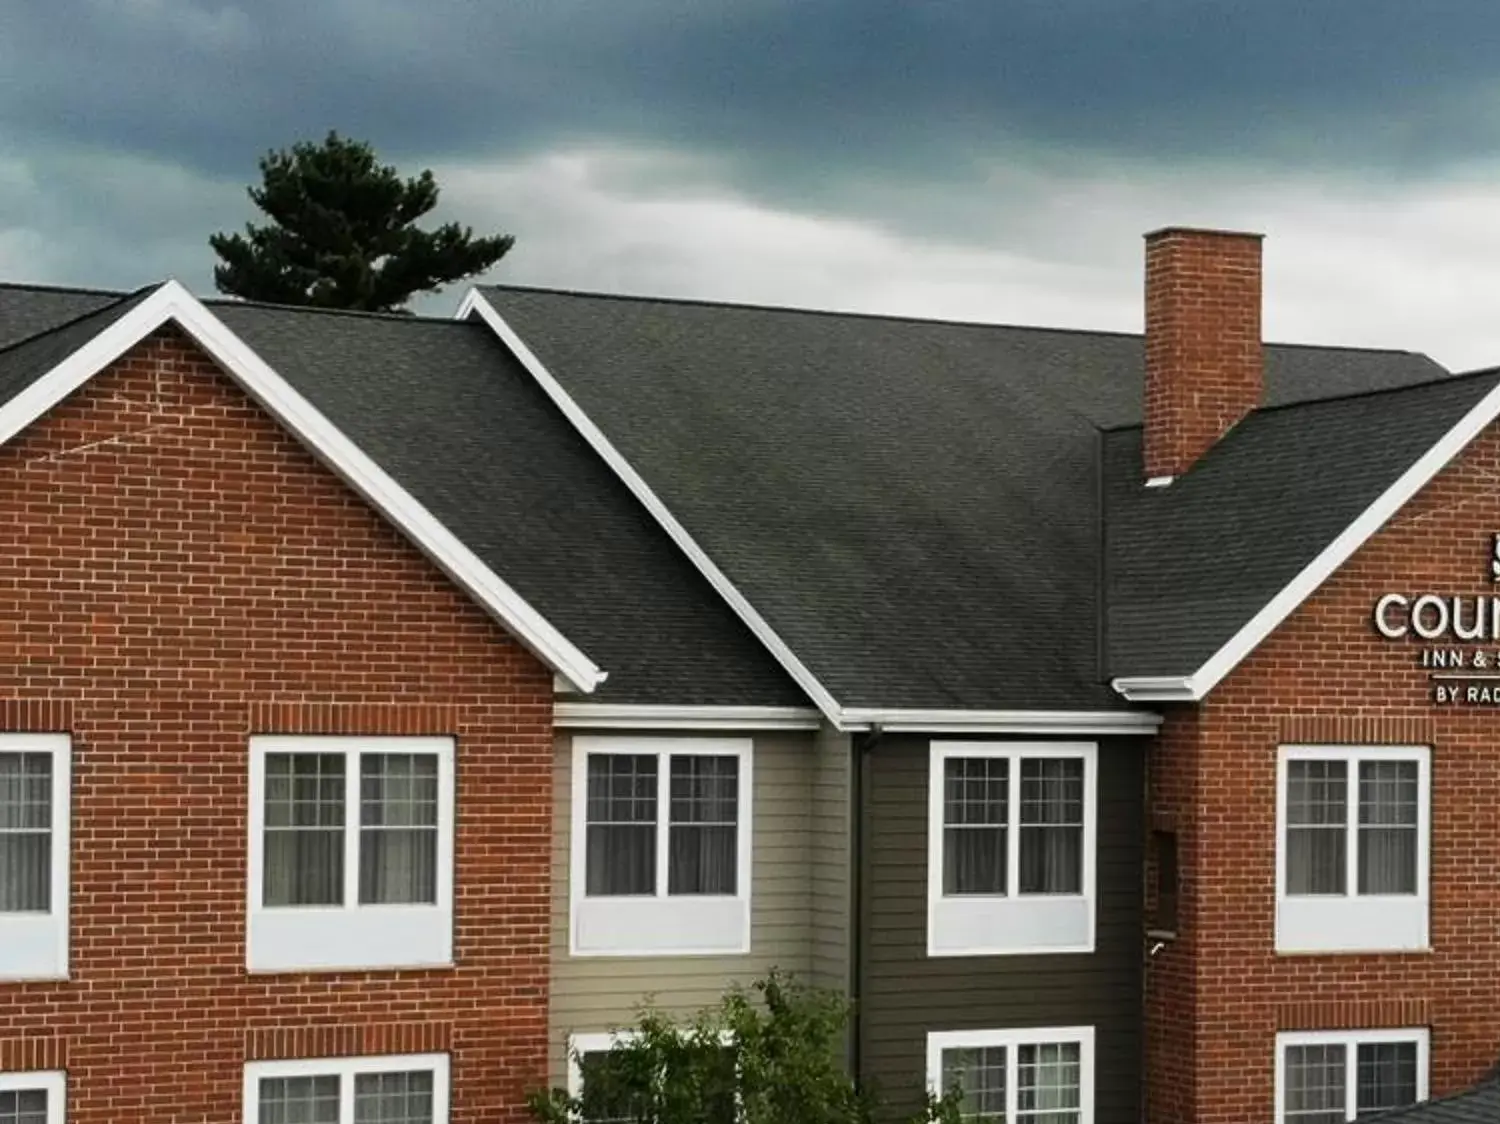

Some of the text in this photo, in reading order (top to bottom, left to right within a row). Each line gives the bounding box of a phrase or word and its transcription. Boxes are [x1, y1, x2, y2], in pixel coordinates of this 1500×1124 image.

[1422, 650, 1464, 667] INN
[1473, 651, 1488, 668] &
[1436, 686, 1460, 703] BY
